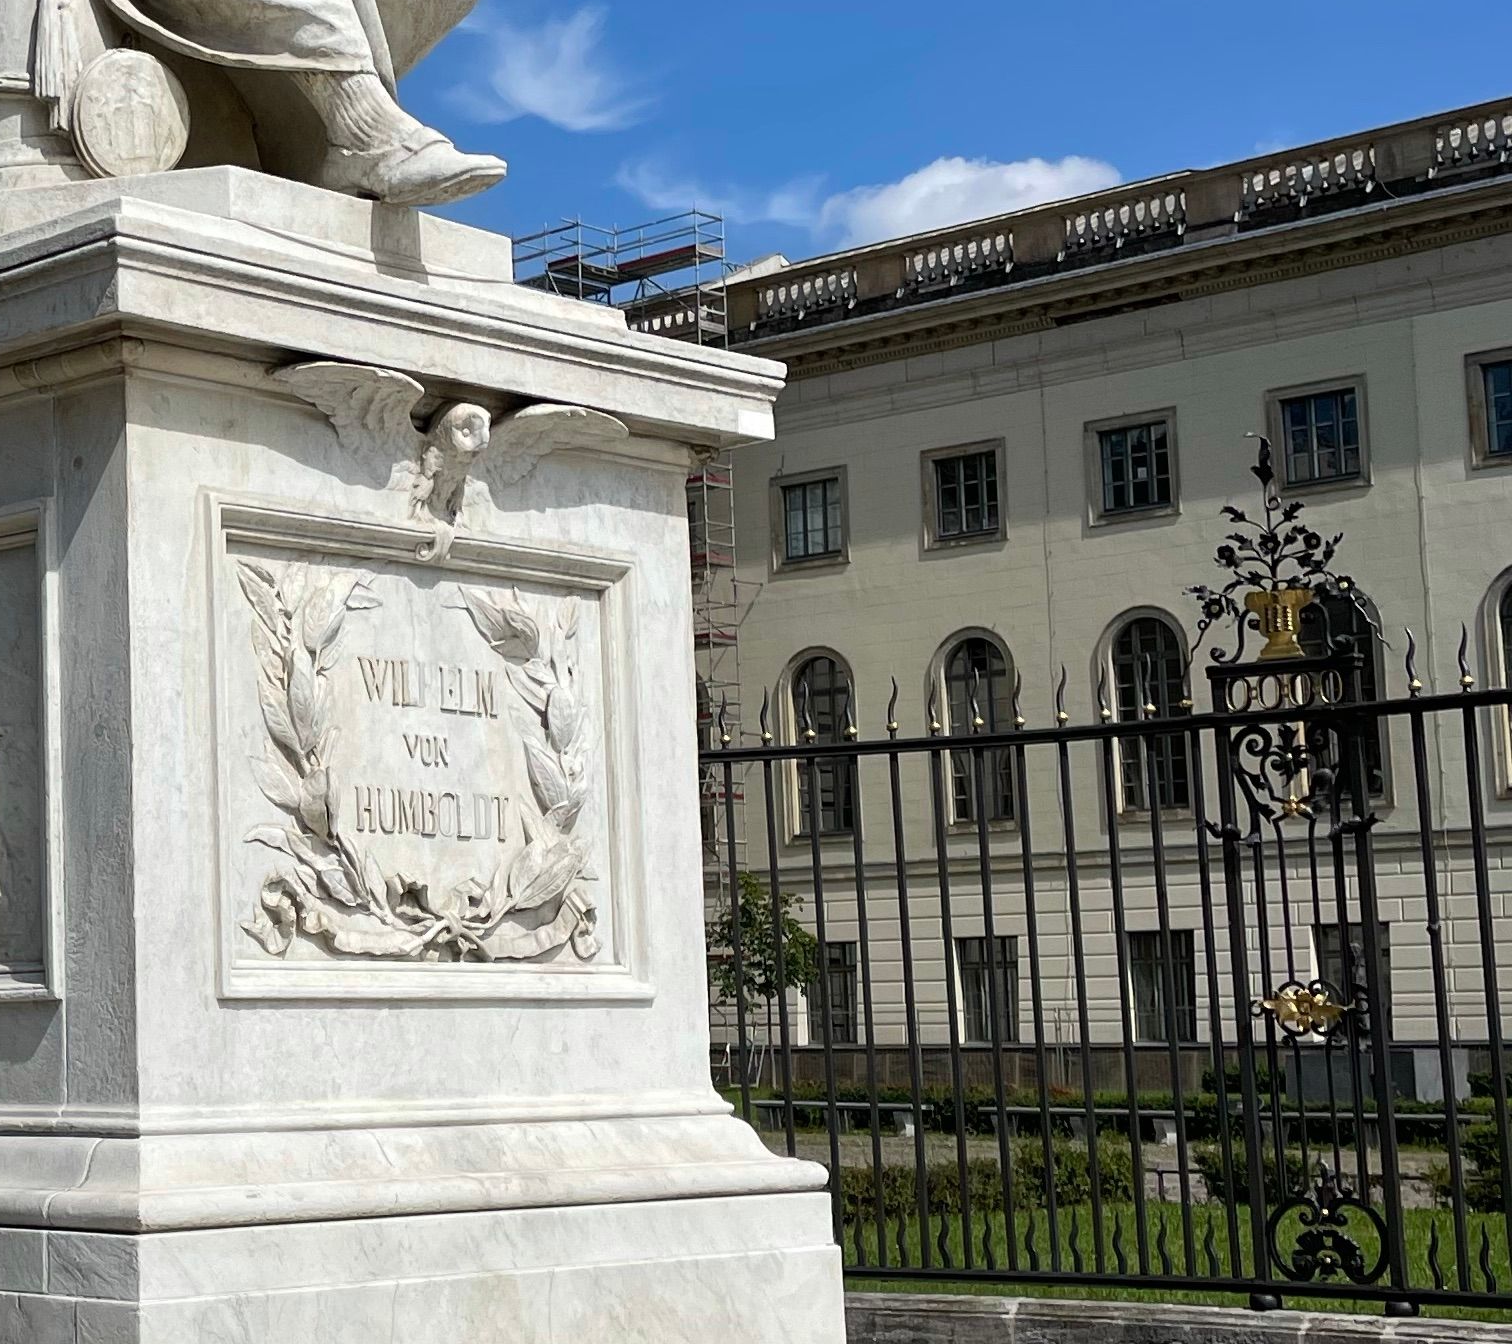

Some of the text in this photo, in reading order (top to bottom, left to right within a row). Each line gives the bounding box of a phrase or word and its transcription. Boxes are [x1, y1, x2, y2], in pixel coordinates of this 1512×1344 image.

[357, 656, 498, 720] WILHELM
[402, 733, 449, 768] VON
[354, 784, 509, 843] HUMBOLDT
